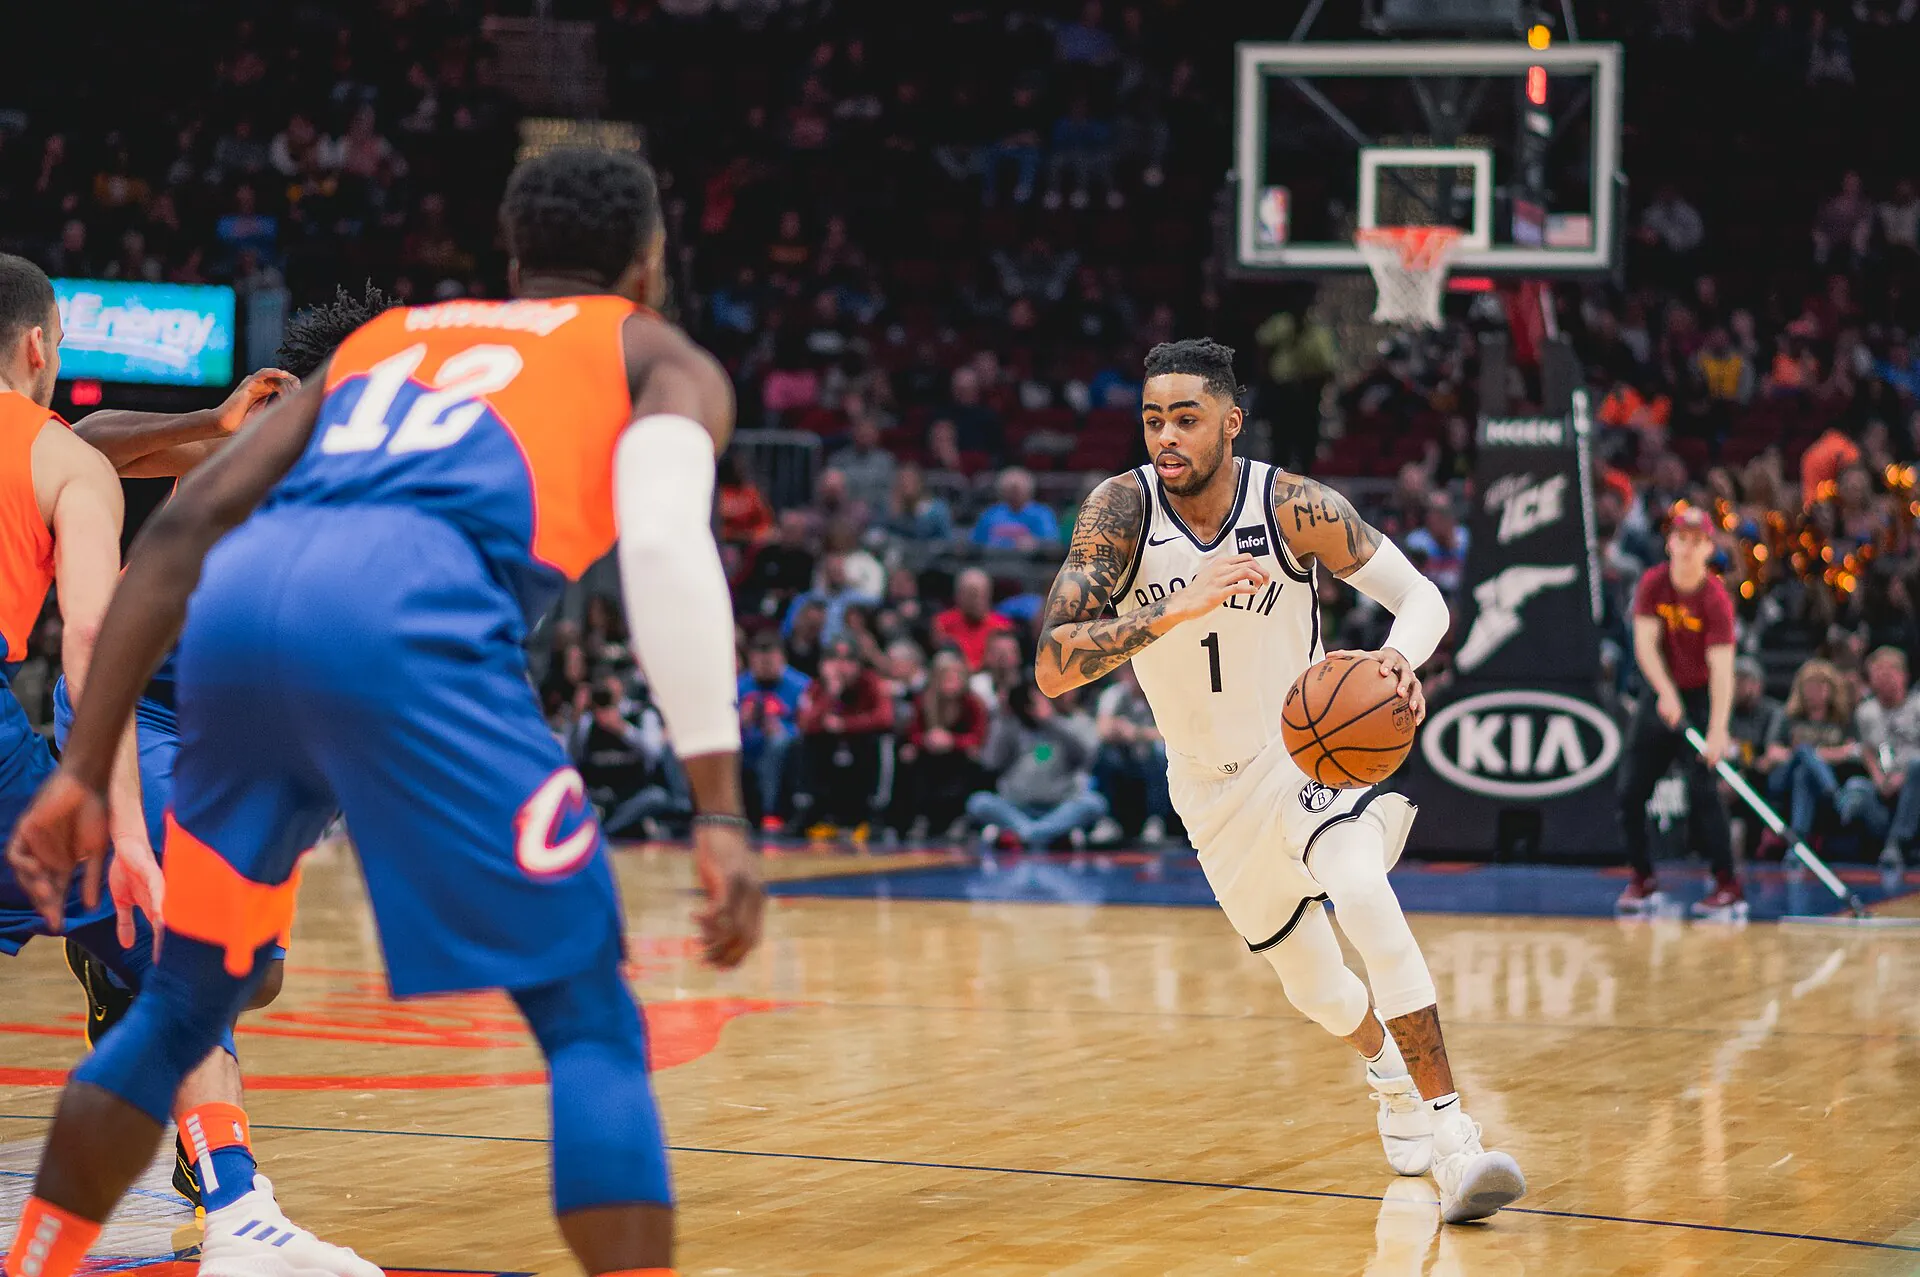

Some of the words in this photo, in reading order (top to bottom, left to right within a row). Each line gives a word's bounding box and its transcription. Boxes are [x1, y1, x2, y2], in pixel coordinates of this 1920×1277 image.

[321, 342, 524, 454] 12
[1237, 535, 1266, 550] infor
[1200, 632, 1223, 693] 1
[1457, 714, 1588, 774] KIA
[512, 764, 599, 878] C
